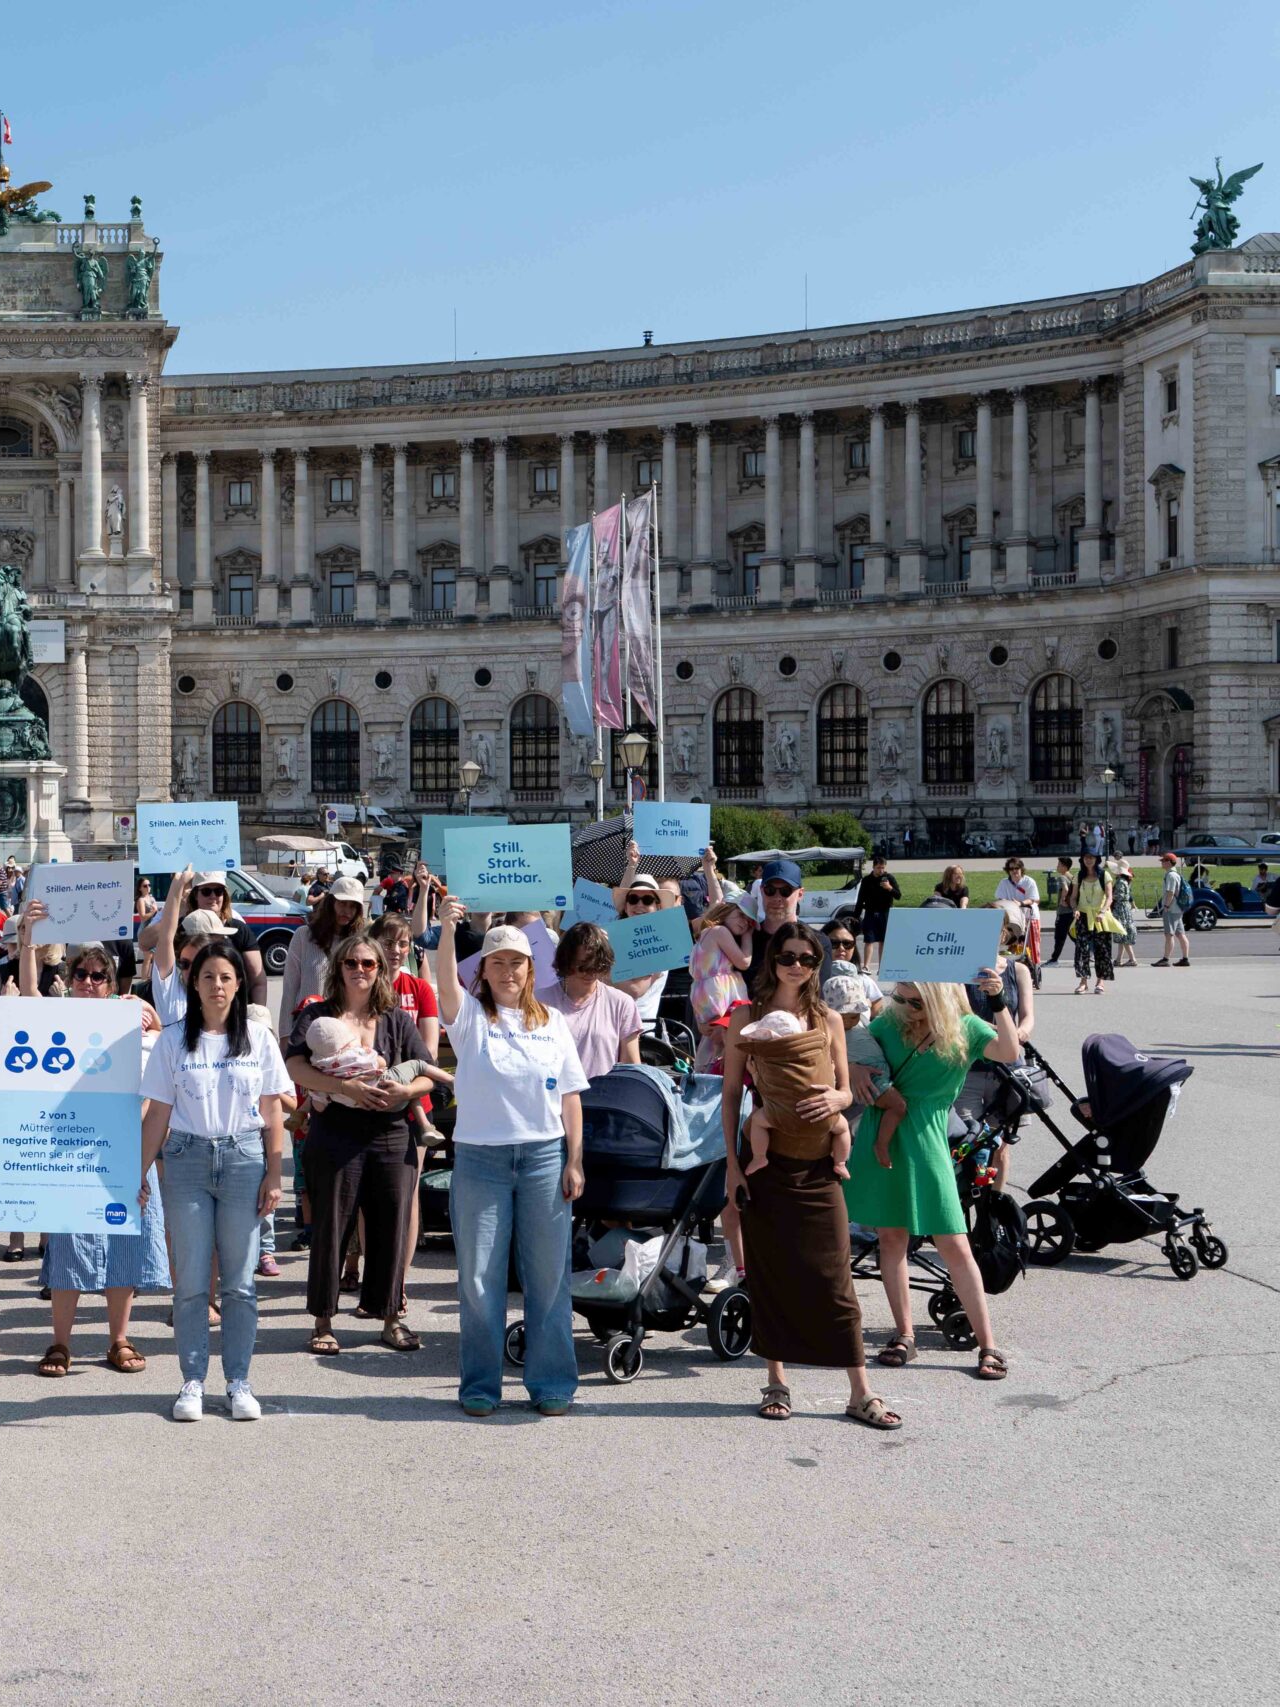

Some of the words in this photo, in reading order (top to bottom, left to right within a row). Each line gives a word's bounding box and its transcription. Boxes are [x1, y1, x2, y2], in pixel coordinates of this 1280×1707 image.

[149, 820, 177, 828] Stillen.
[178, 819, 200, 827] Mein
[661, 819, 683, 828] Chill,
[655, 828, 668, 836] ich
[670, 829, 688, 837] still!
[493, 842, 524, 854] Still.
[488, 857, 531, 869] Stark.
[478, 872, 542, 885] Sichtbar.
[46, 885, 74, 893] Stillen.
[75, 882, 95, 891] Mein
[97, 881, 122, 889] Recht.
[602, 902, 616, 910] Mei
[633, 926, 656, 937] Still.
[632, 935, 662, 948] Stark.
[926, 932, 958, 943] Chill,
[627, 944, 672, 960] Sichtbar.
[915, 945, 935, 955] ich
[937, 945, 965, 955] still!
[181, 1063, 209, 1072] Stillen.
[212, 1061, 234, 1069] Mein
[39, 1111, 46, 1120] 2
[48, 1112, 67, 1120] von
[70, 1111, 76, 1120] 3
[20, 1123, 54, 1133] Mütter
[56, 1125, 95, 1134] erleben
[2, 1136, 48, 1147] negative
[50, 1137, 112, 1148] Reaktionen,
[20, 1151, 46, 1159] wenn
[49, 1150, 63, 1159] sie
[65, 1151, 75, 1160] in
[77, 1150, 95, 1160] der
[3, 1160, 74, 1173] Öffentlichkeit
[76, 1163, 110, 1174] stillen.
